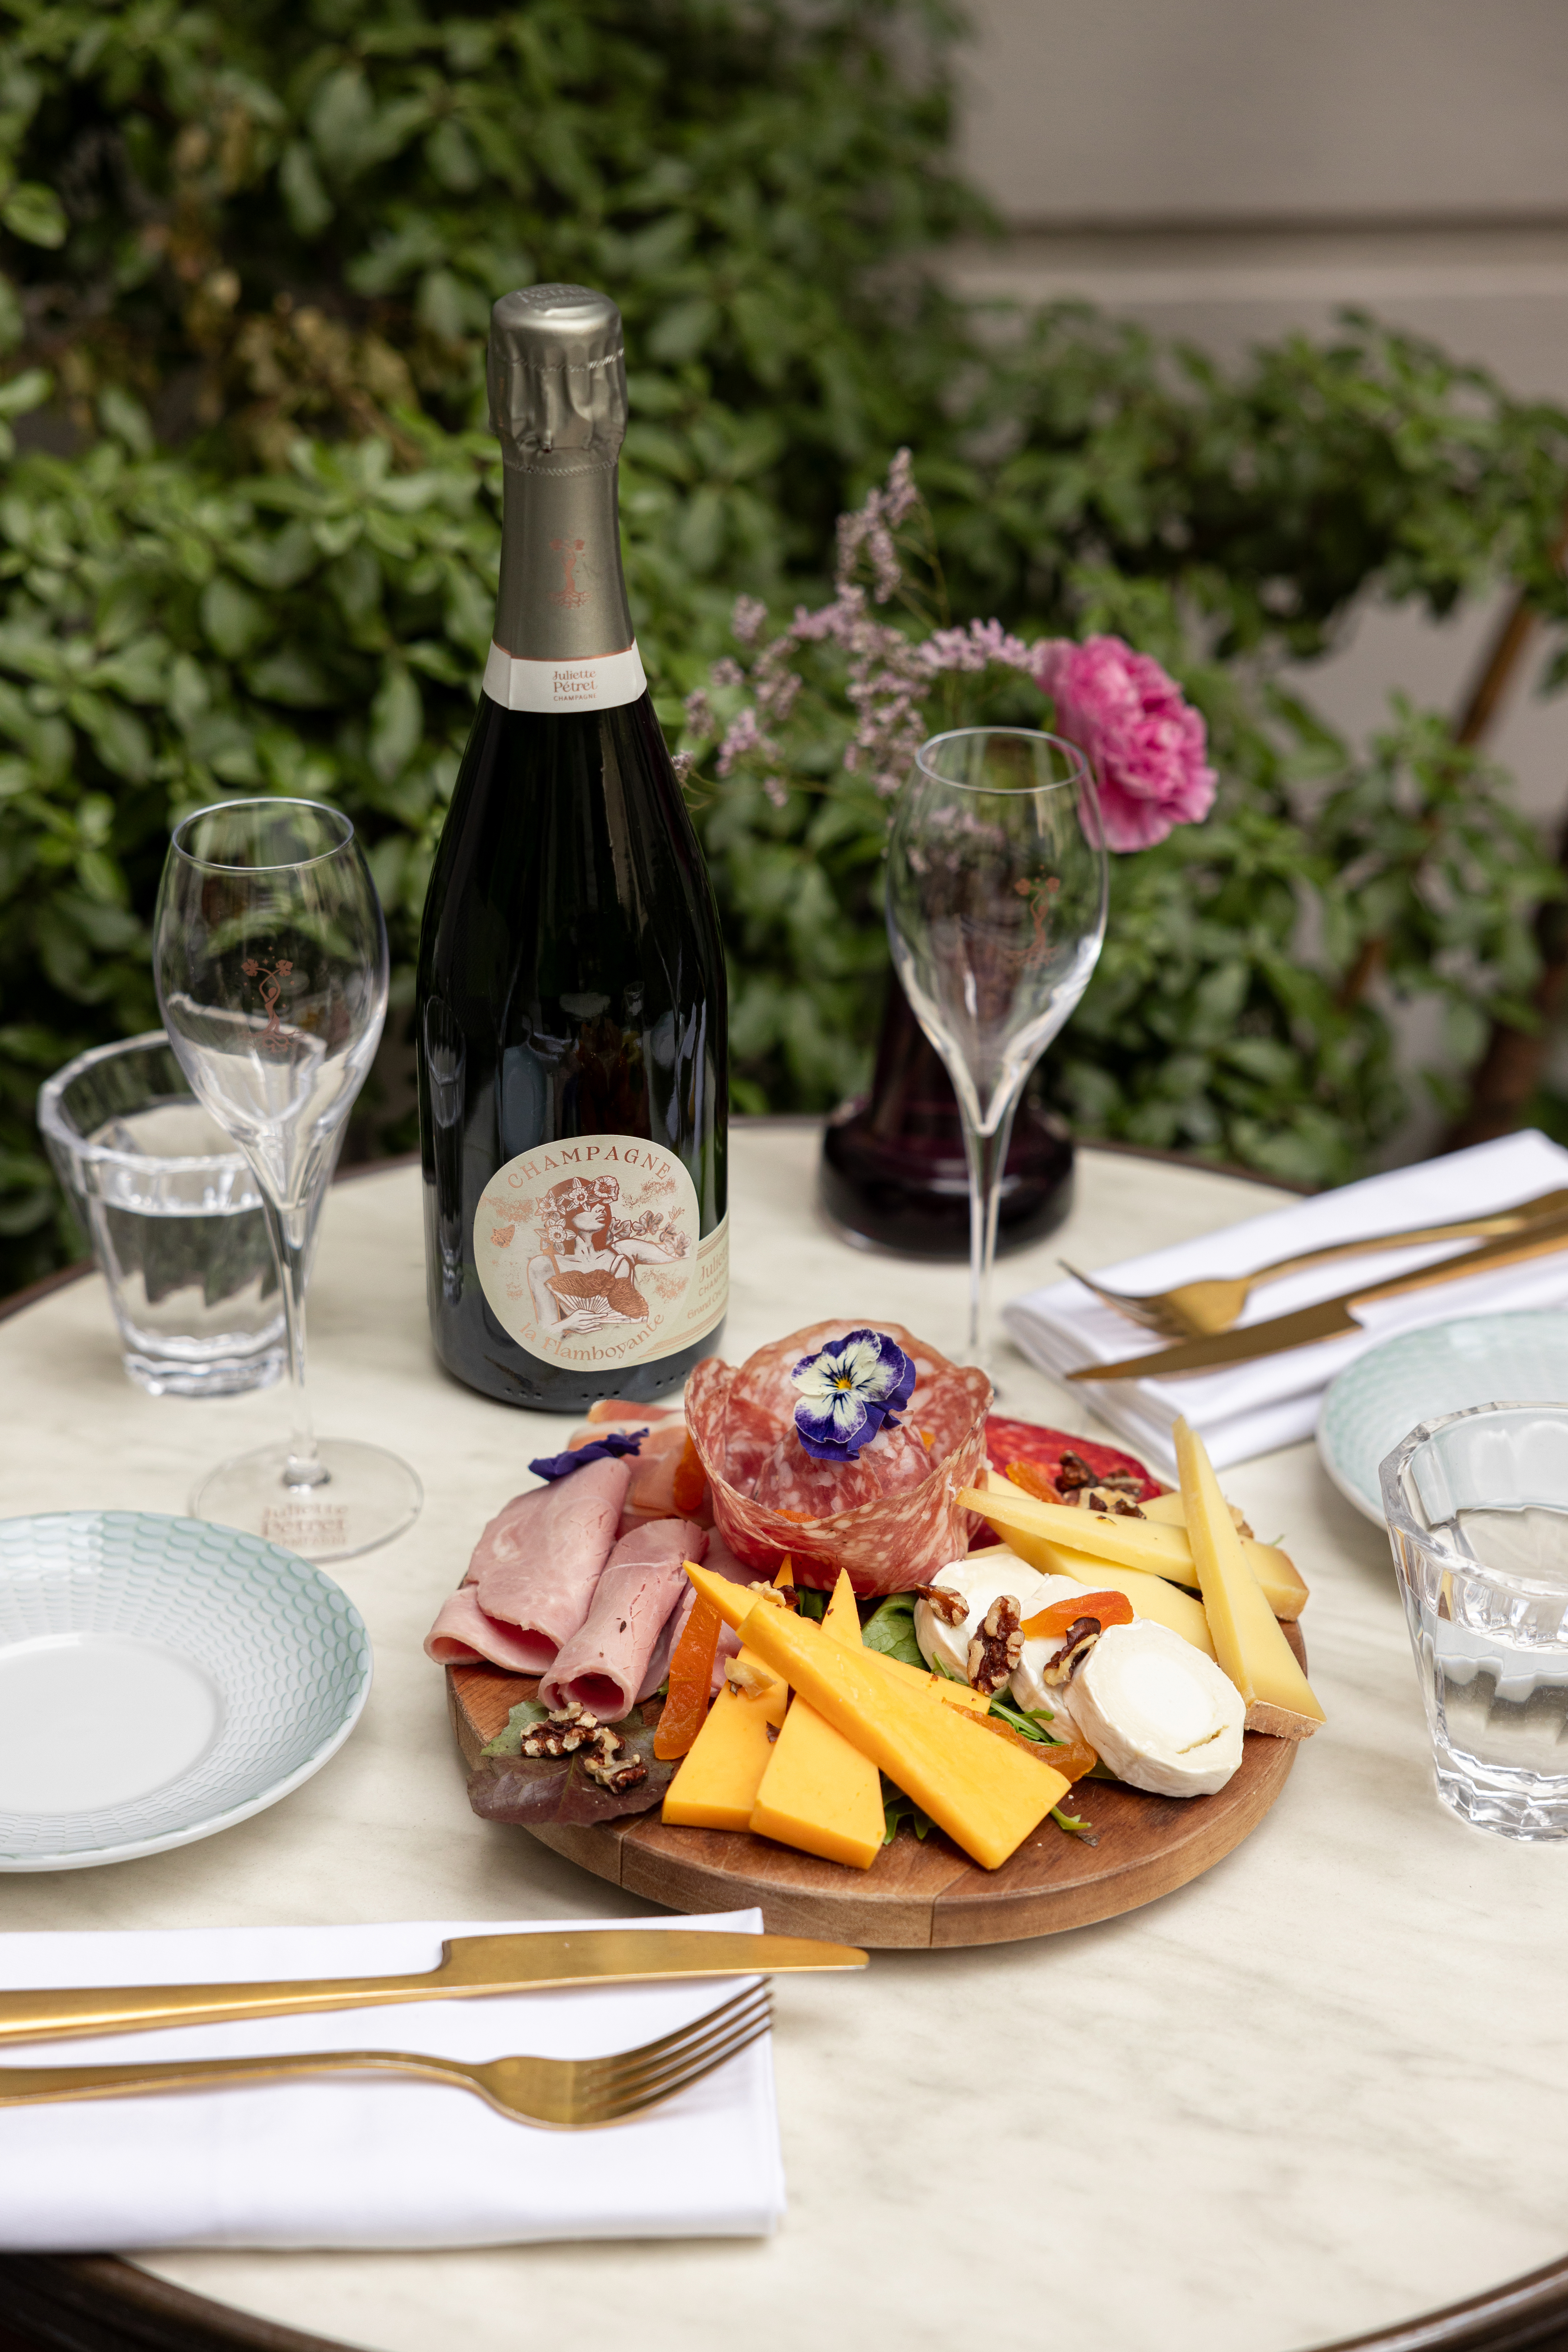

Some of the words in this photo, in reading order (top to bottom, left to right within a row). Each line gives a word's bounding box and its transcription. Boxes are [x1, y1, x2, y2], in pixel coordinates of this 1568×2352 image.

[553, 670, 597, 681] Juliette
[554, 680, 598, 693] Pétret
[554, 693, 597, 702] CHAMPAGNE
[508, 1146, 671, 1189] CHAMPAGNE
[687, 1297, 711, 1319] Grand
[519, 1322, 537, 1342] la
[541, 1314, 664, 1361] Flamboyante
